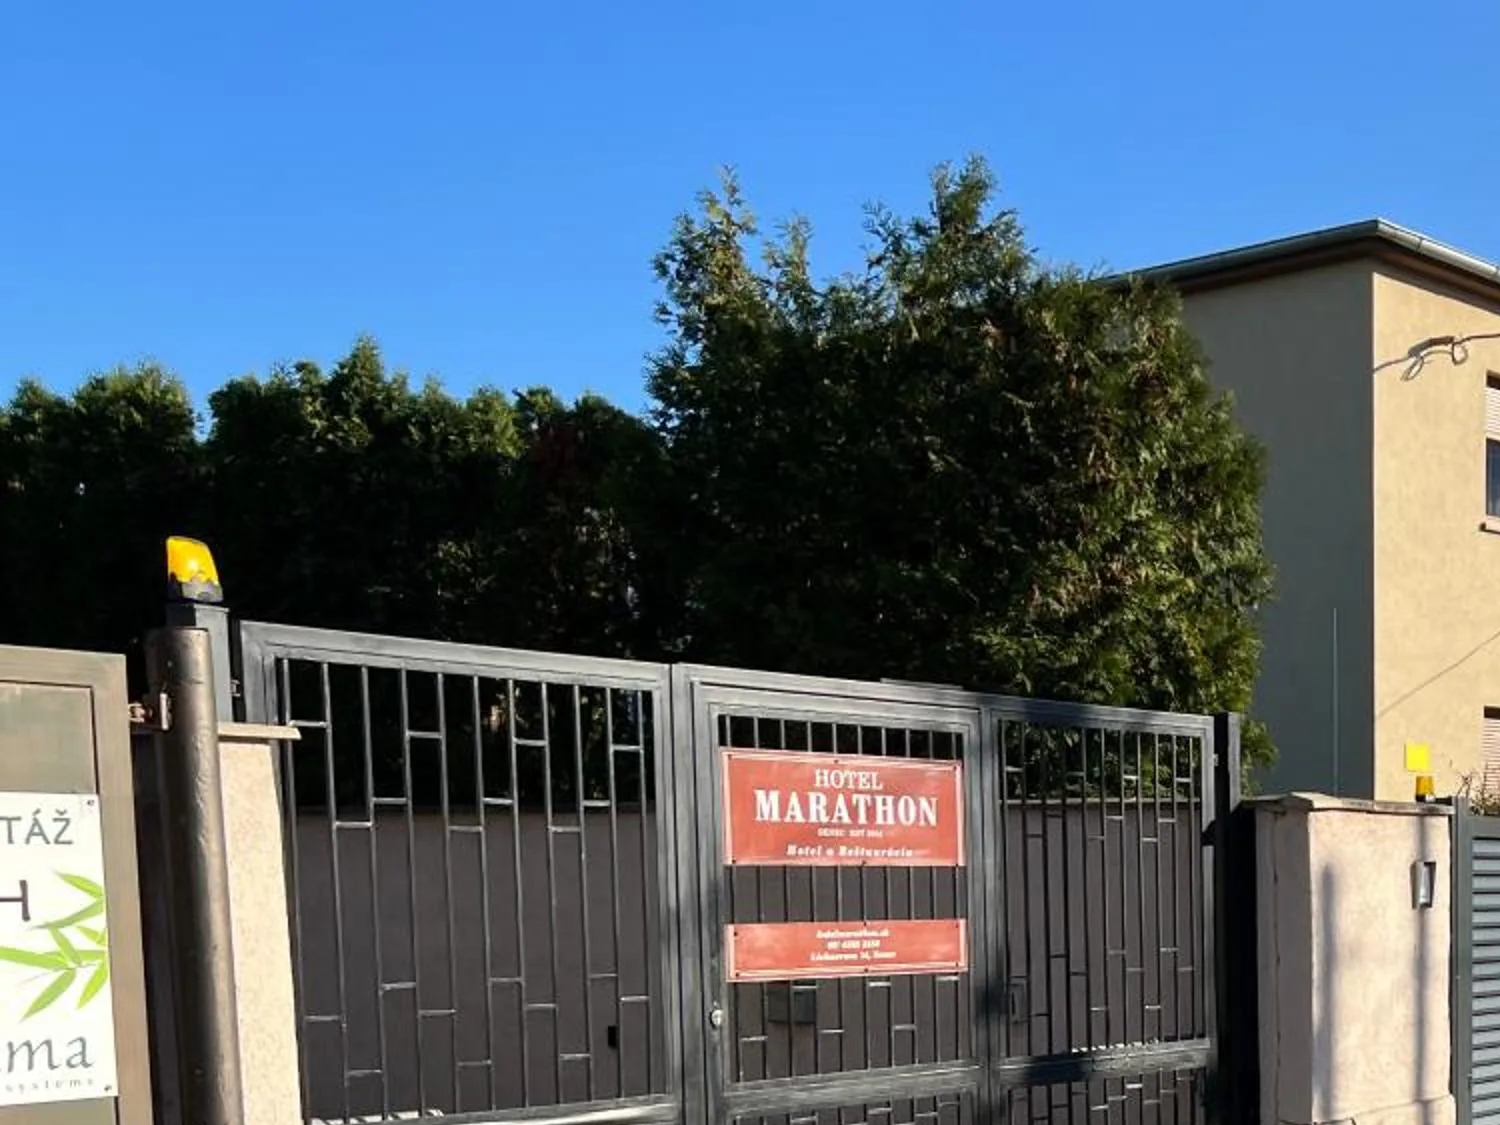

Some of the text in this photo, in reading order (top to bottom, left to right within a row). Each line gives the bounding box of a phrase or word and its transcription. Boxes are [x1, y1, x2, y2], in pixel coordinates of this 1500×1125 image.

[814, 768, 884, 790] HOTEL
[0, 808, 74, 845] TÁŽ
[753, 789, 938, 827] MARATHON
